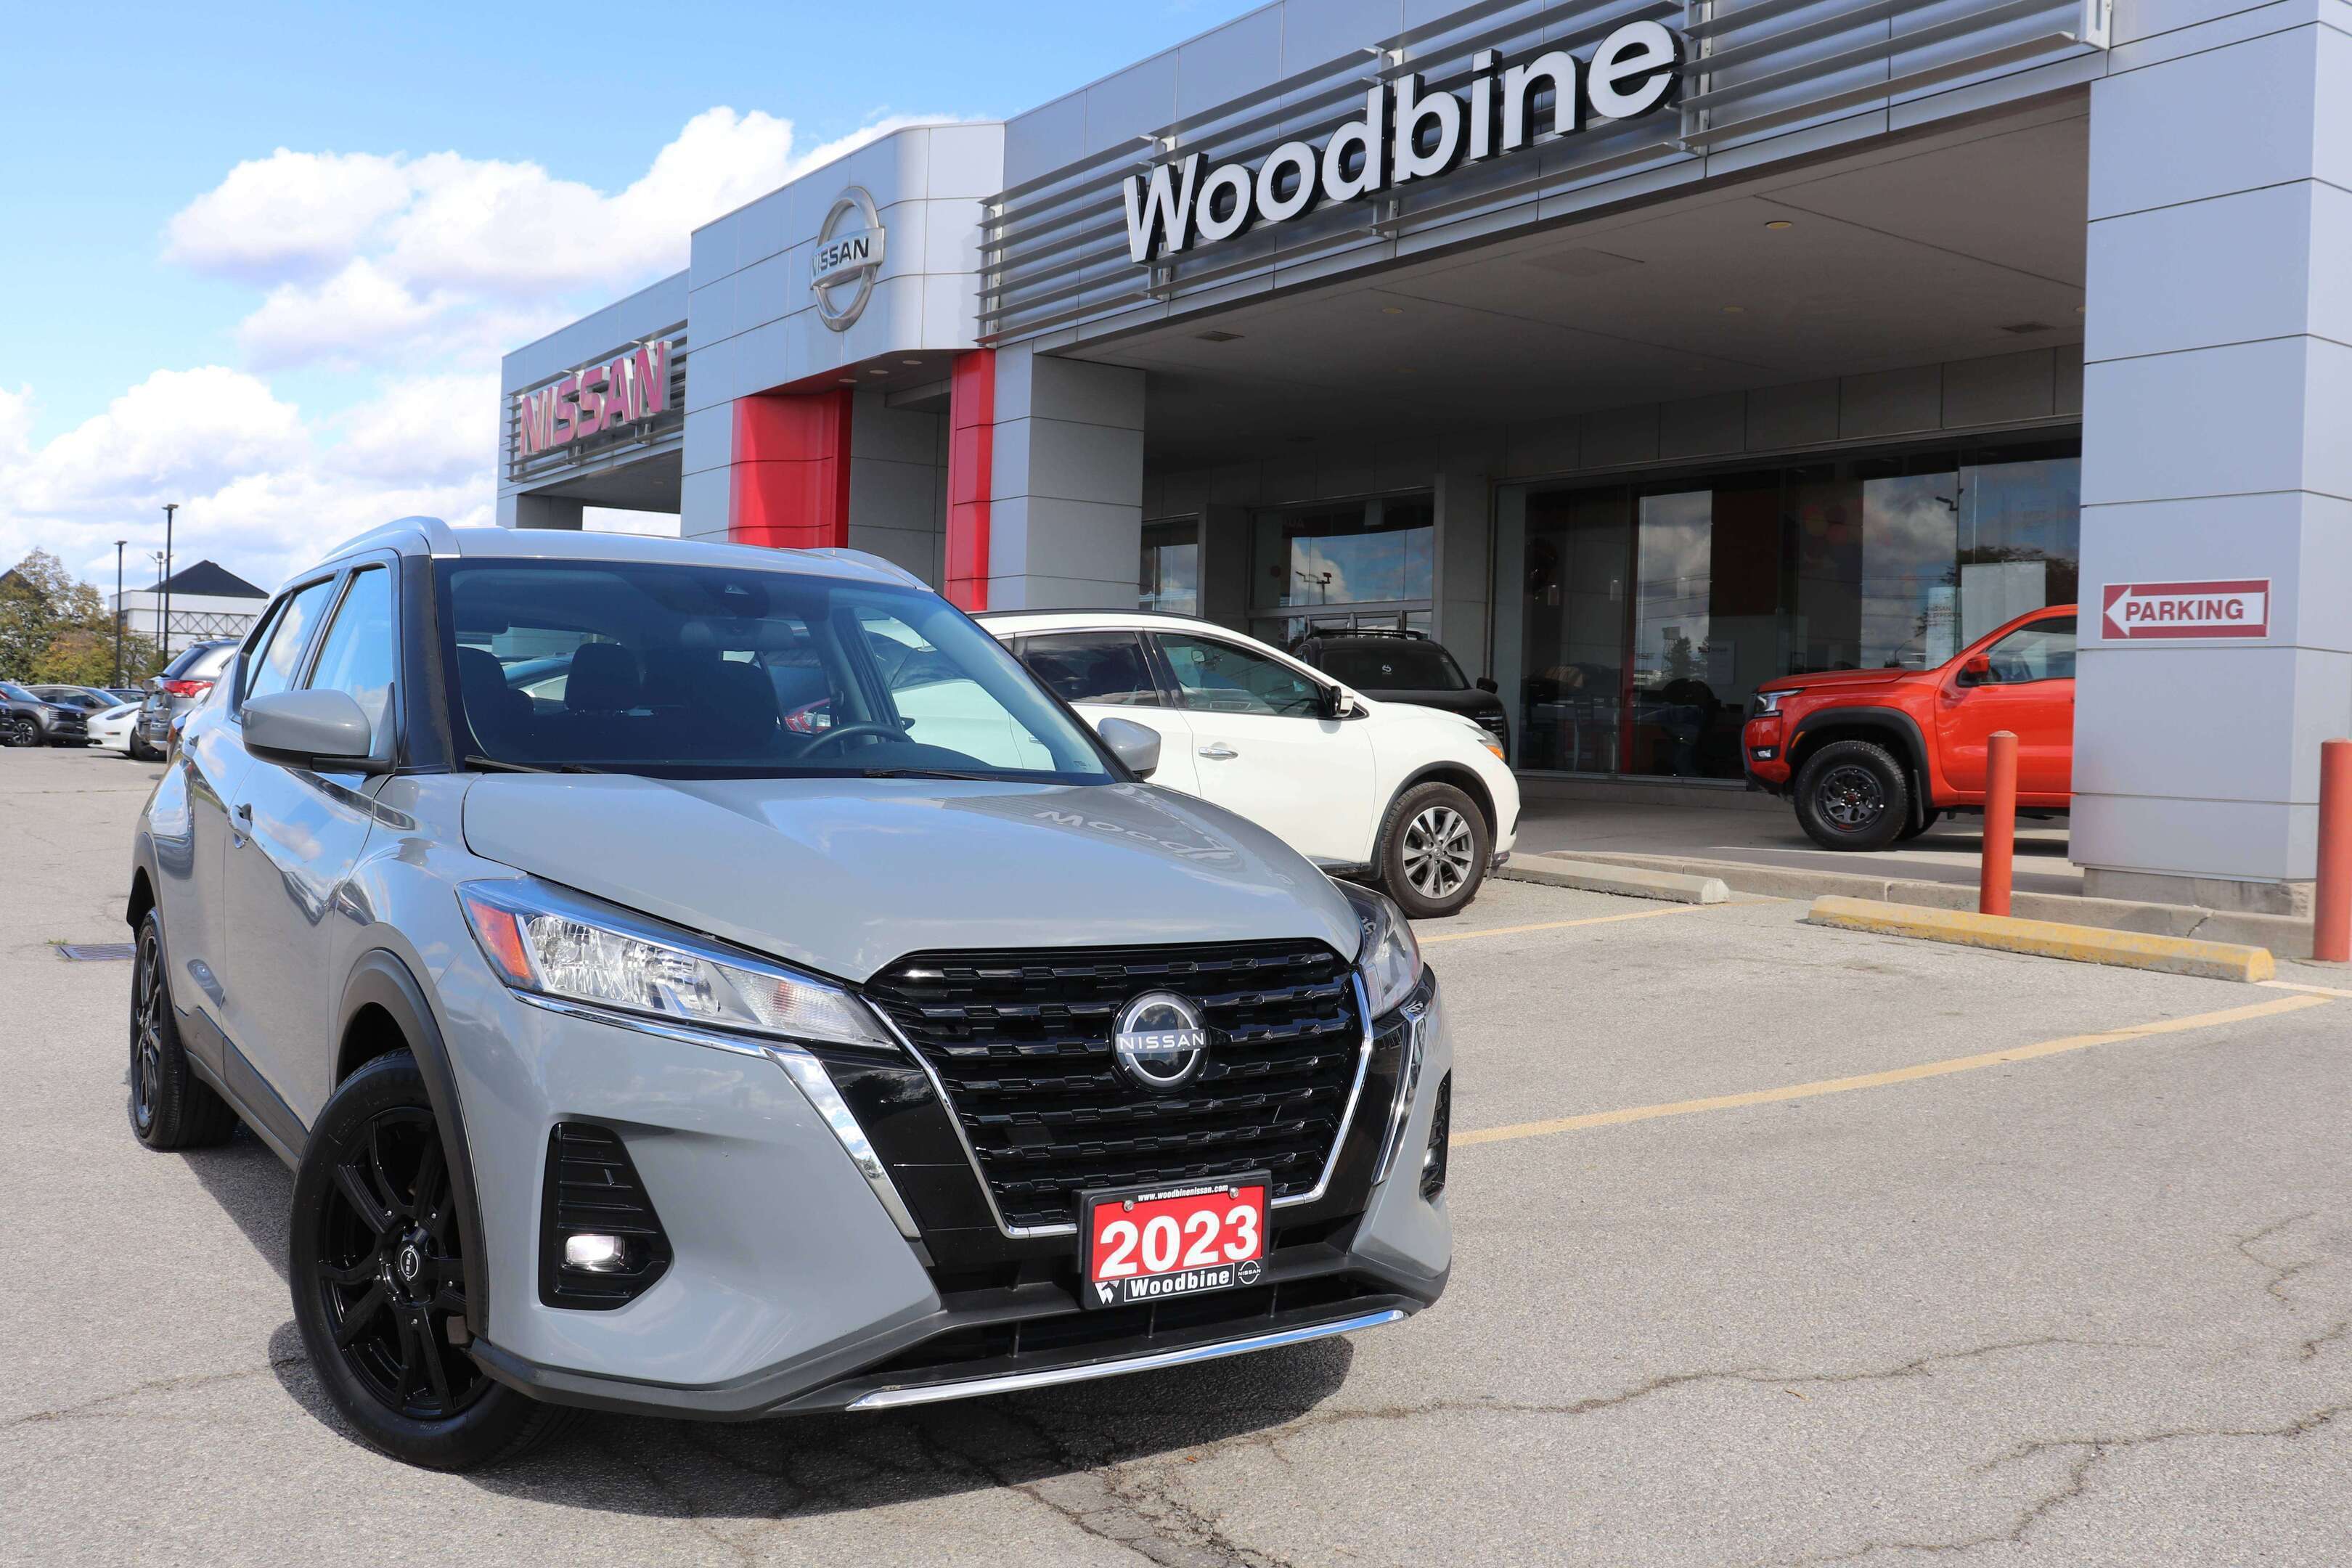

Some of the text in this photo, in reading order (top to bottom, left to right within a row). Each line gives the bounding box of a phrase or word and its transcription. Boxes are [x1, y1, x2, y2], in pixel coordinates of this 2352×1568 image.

[1123, 20, 1684, 265] Woodbine
[519, 340, 671, 458] NISSAN
[2125, 598, 2245, 621] PARKING
[1119, 1032, 1205, 1050] NISSAN
[1138, 1184, 1229, 1202] www.woodbinenissan.com
[1098, 1204, 1259, 1279] 2023
[1130, 1268, 1230, 1298] Woodbine
[1237, 1267, 1262, 1277] NISSAN
